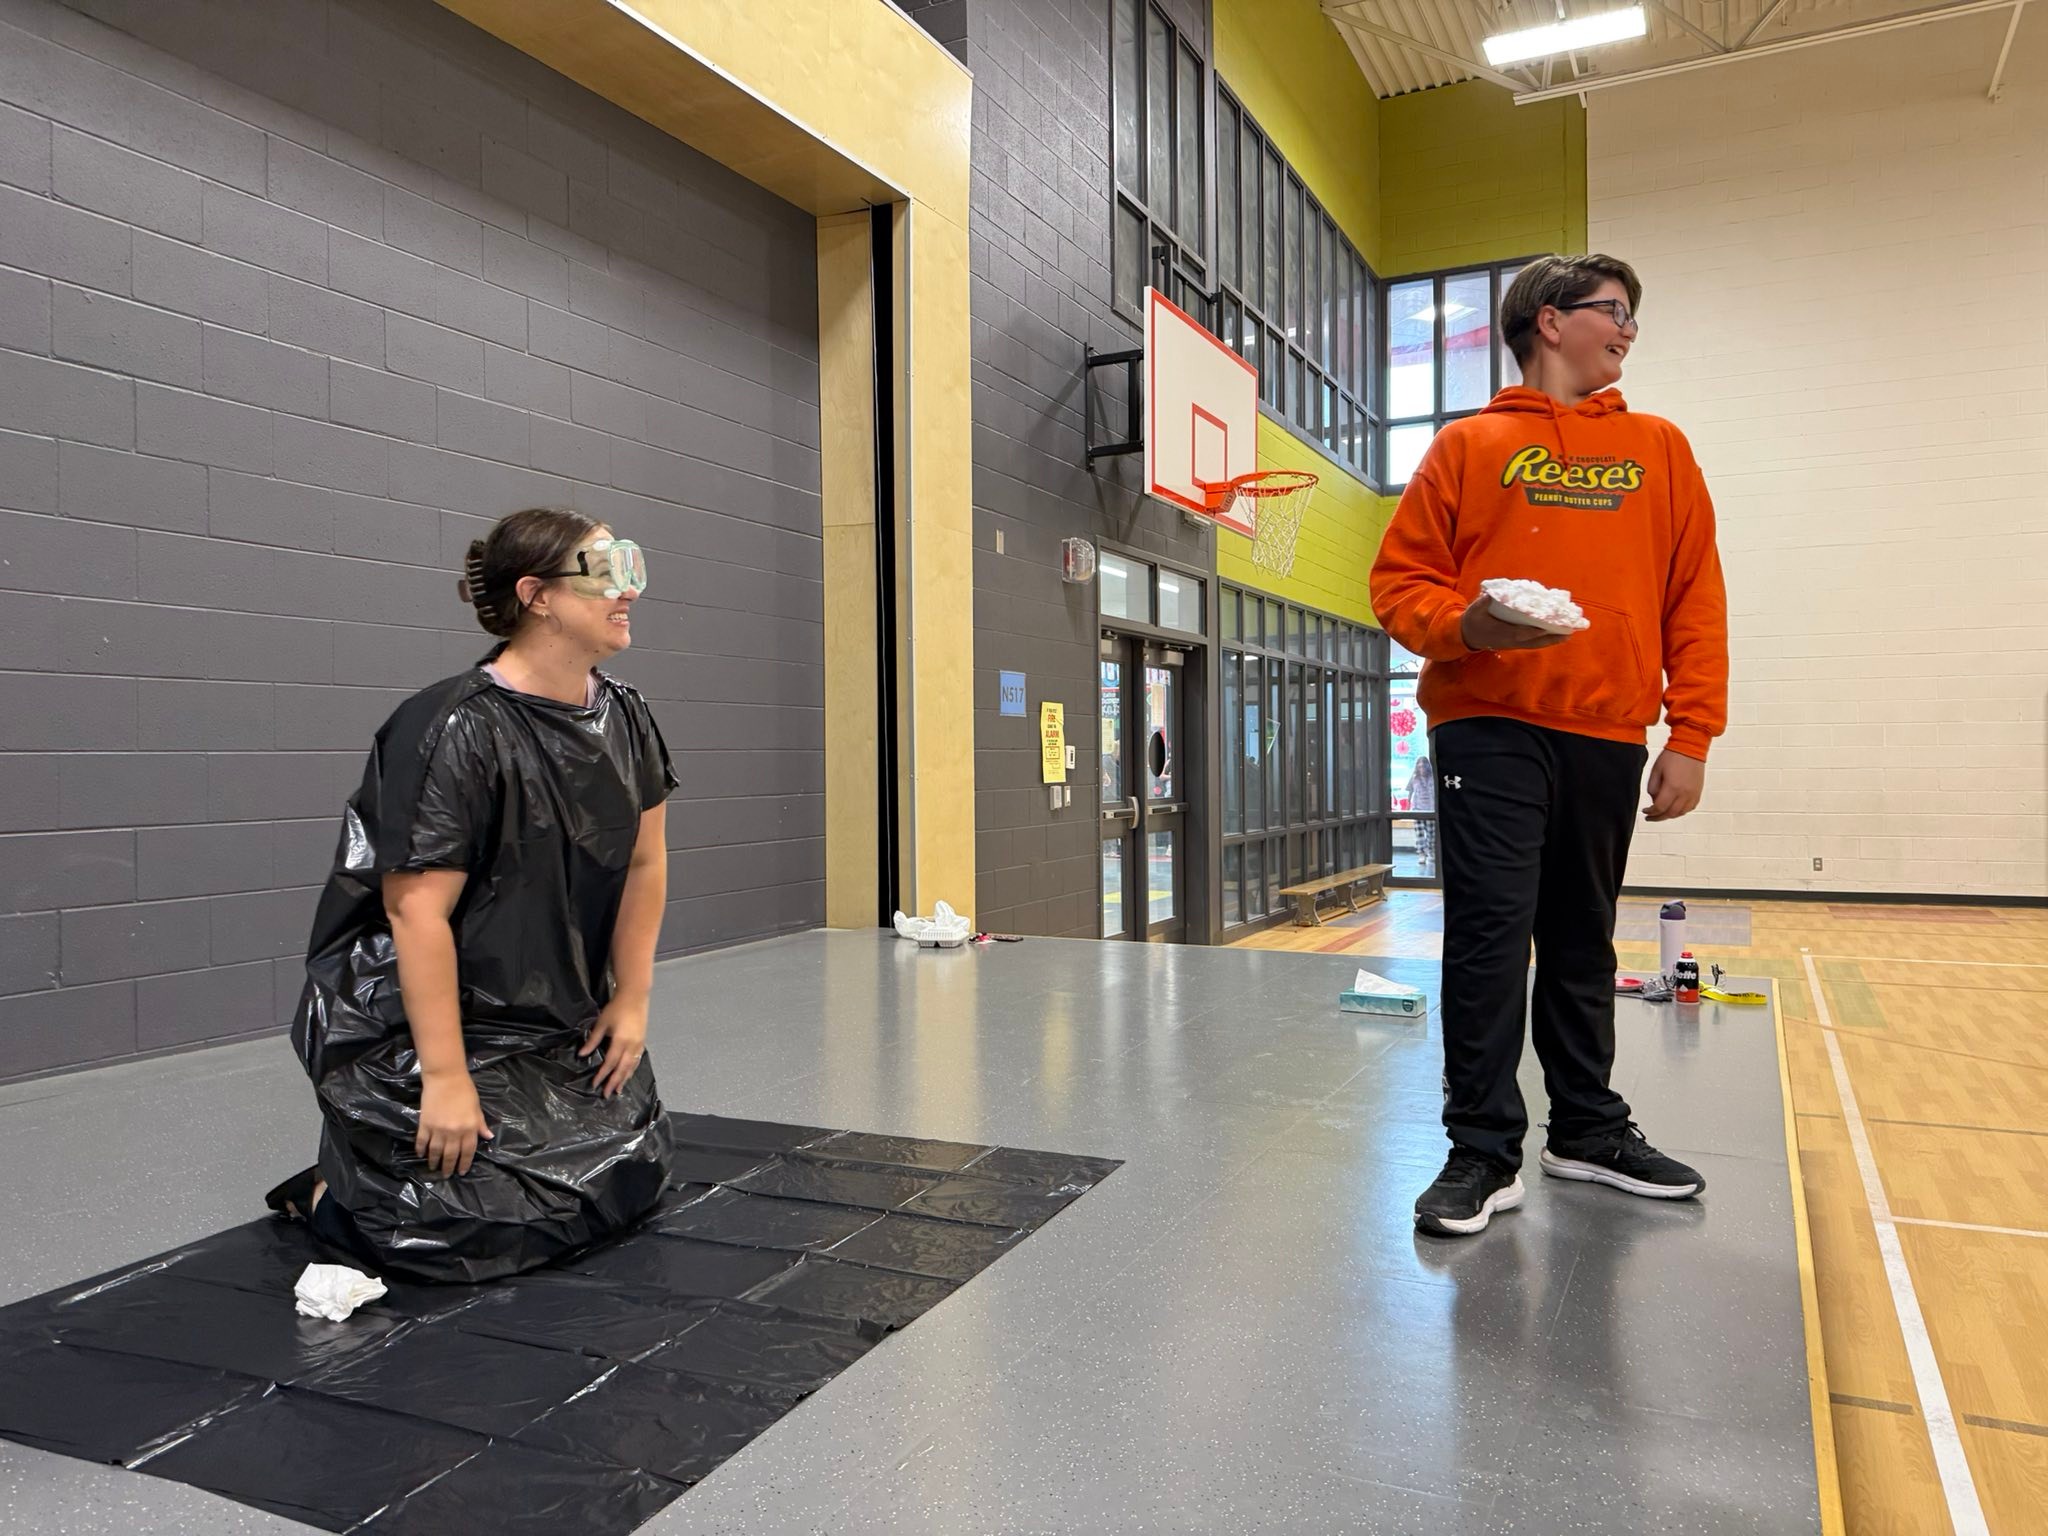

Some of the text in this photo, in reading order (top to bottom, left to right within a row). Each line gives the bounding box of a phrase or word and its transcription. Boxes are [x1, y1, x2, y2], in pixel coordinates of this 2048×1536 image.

[1576, 455, 1616, 463] CHOCOLATE
[1501, 445, 1645, 492] Reese's
[1535, 493, 1613, 507] PEANUT BUTTER CUPS
[1002, 686, 1024, 703] N517
